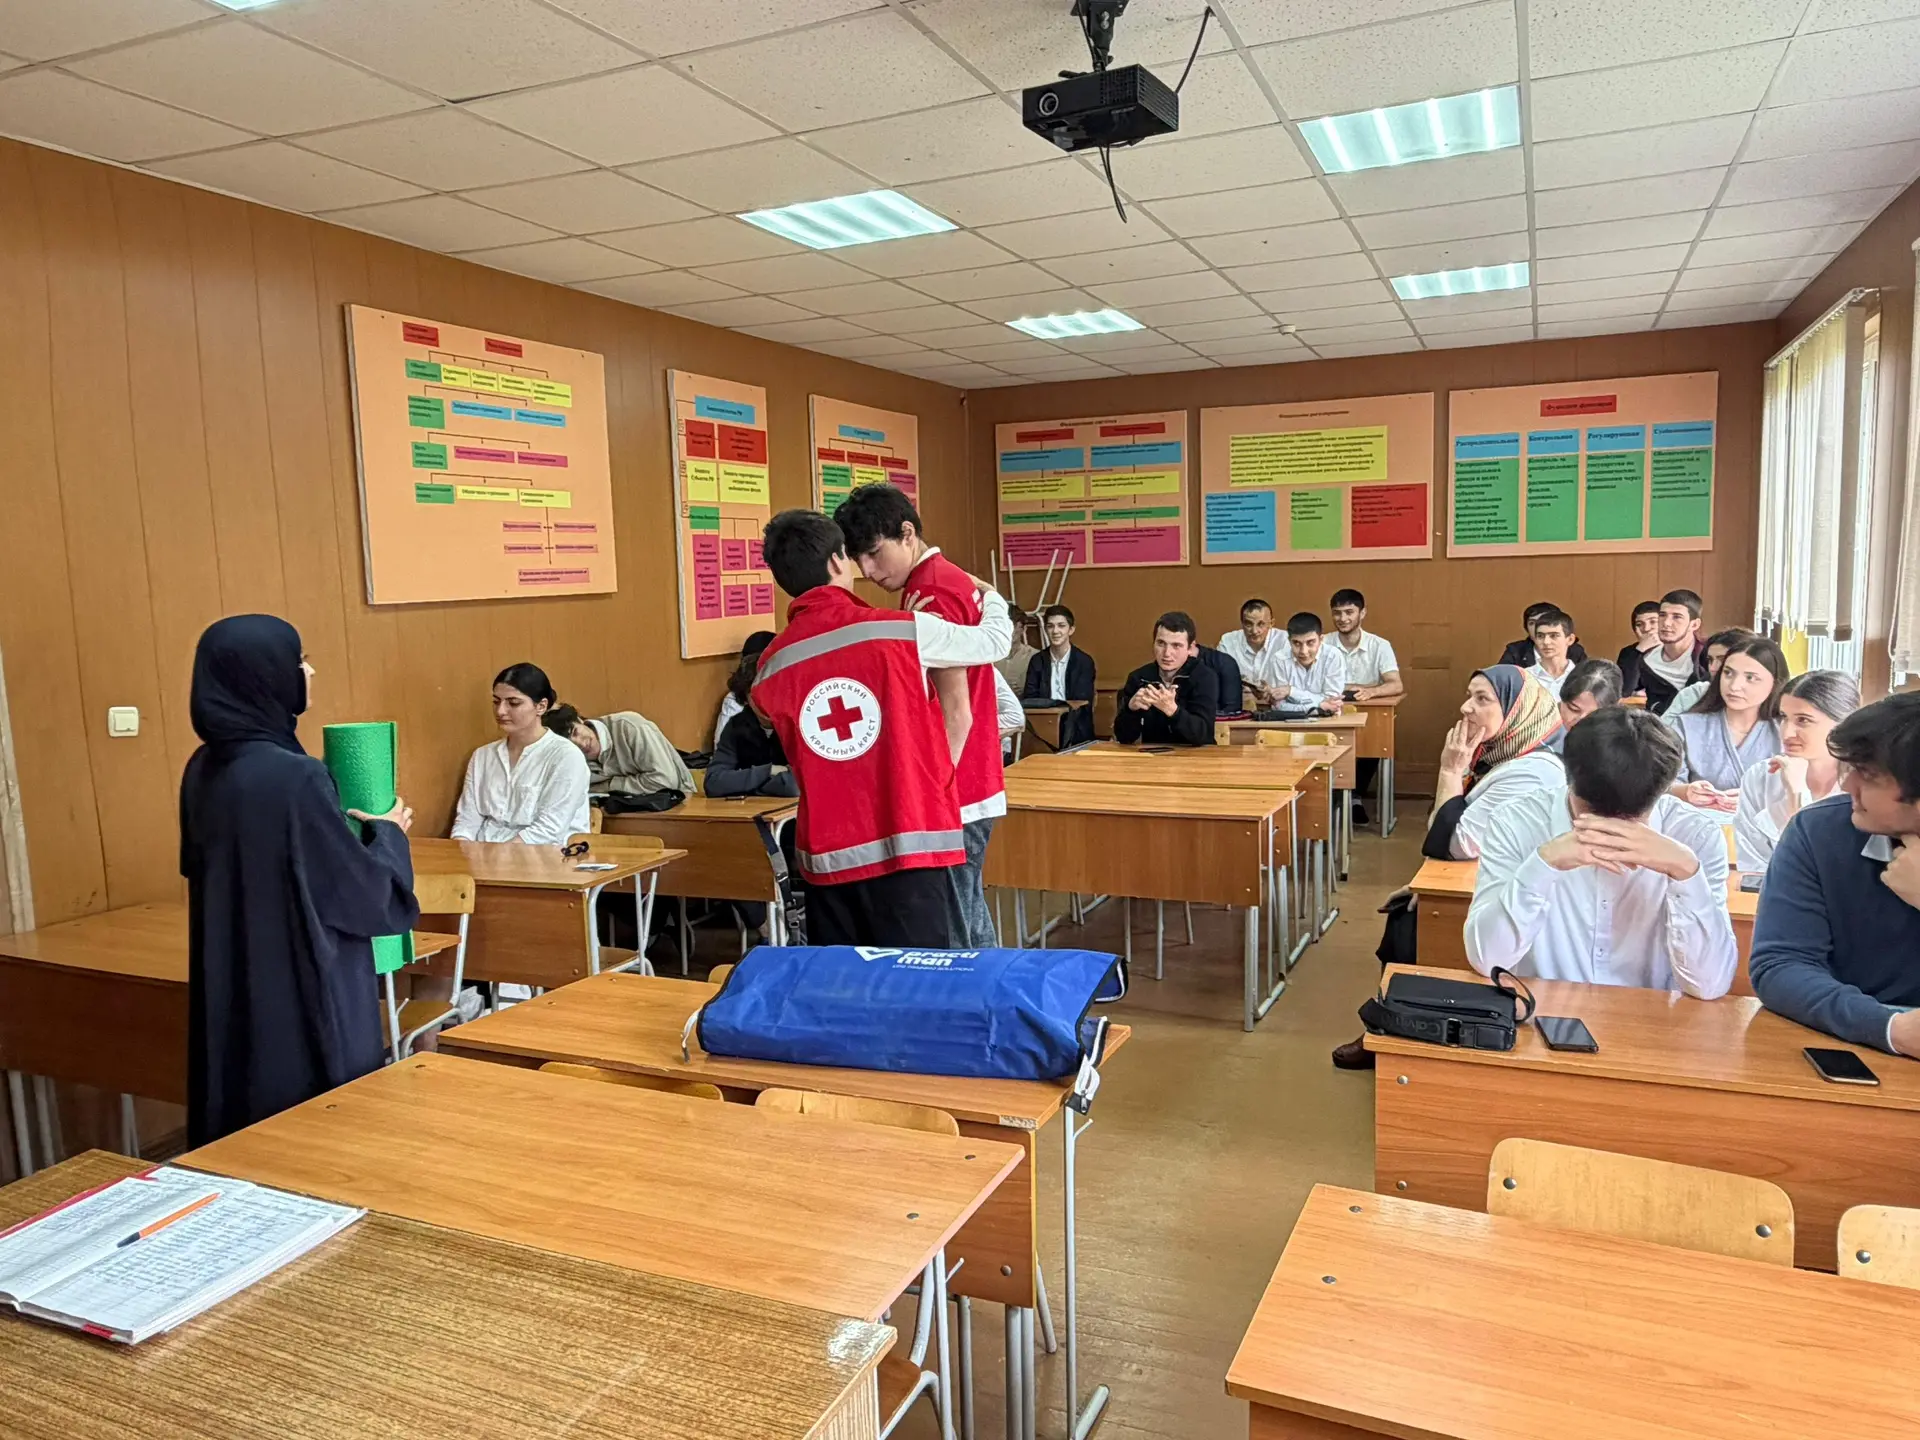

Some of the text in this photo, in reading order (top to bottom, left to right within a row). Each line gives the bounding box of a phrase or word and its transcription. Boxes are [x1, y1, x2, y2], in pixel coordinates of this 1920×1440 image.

[806, 681, 867, 713] РОССИЙСКИЙ
[809, 719, 876, 756] КРАСНЫЙ КРЕСТ
[897, 957, 952, 966] man
